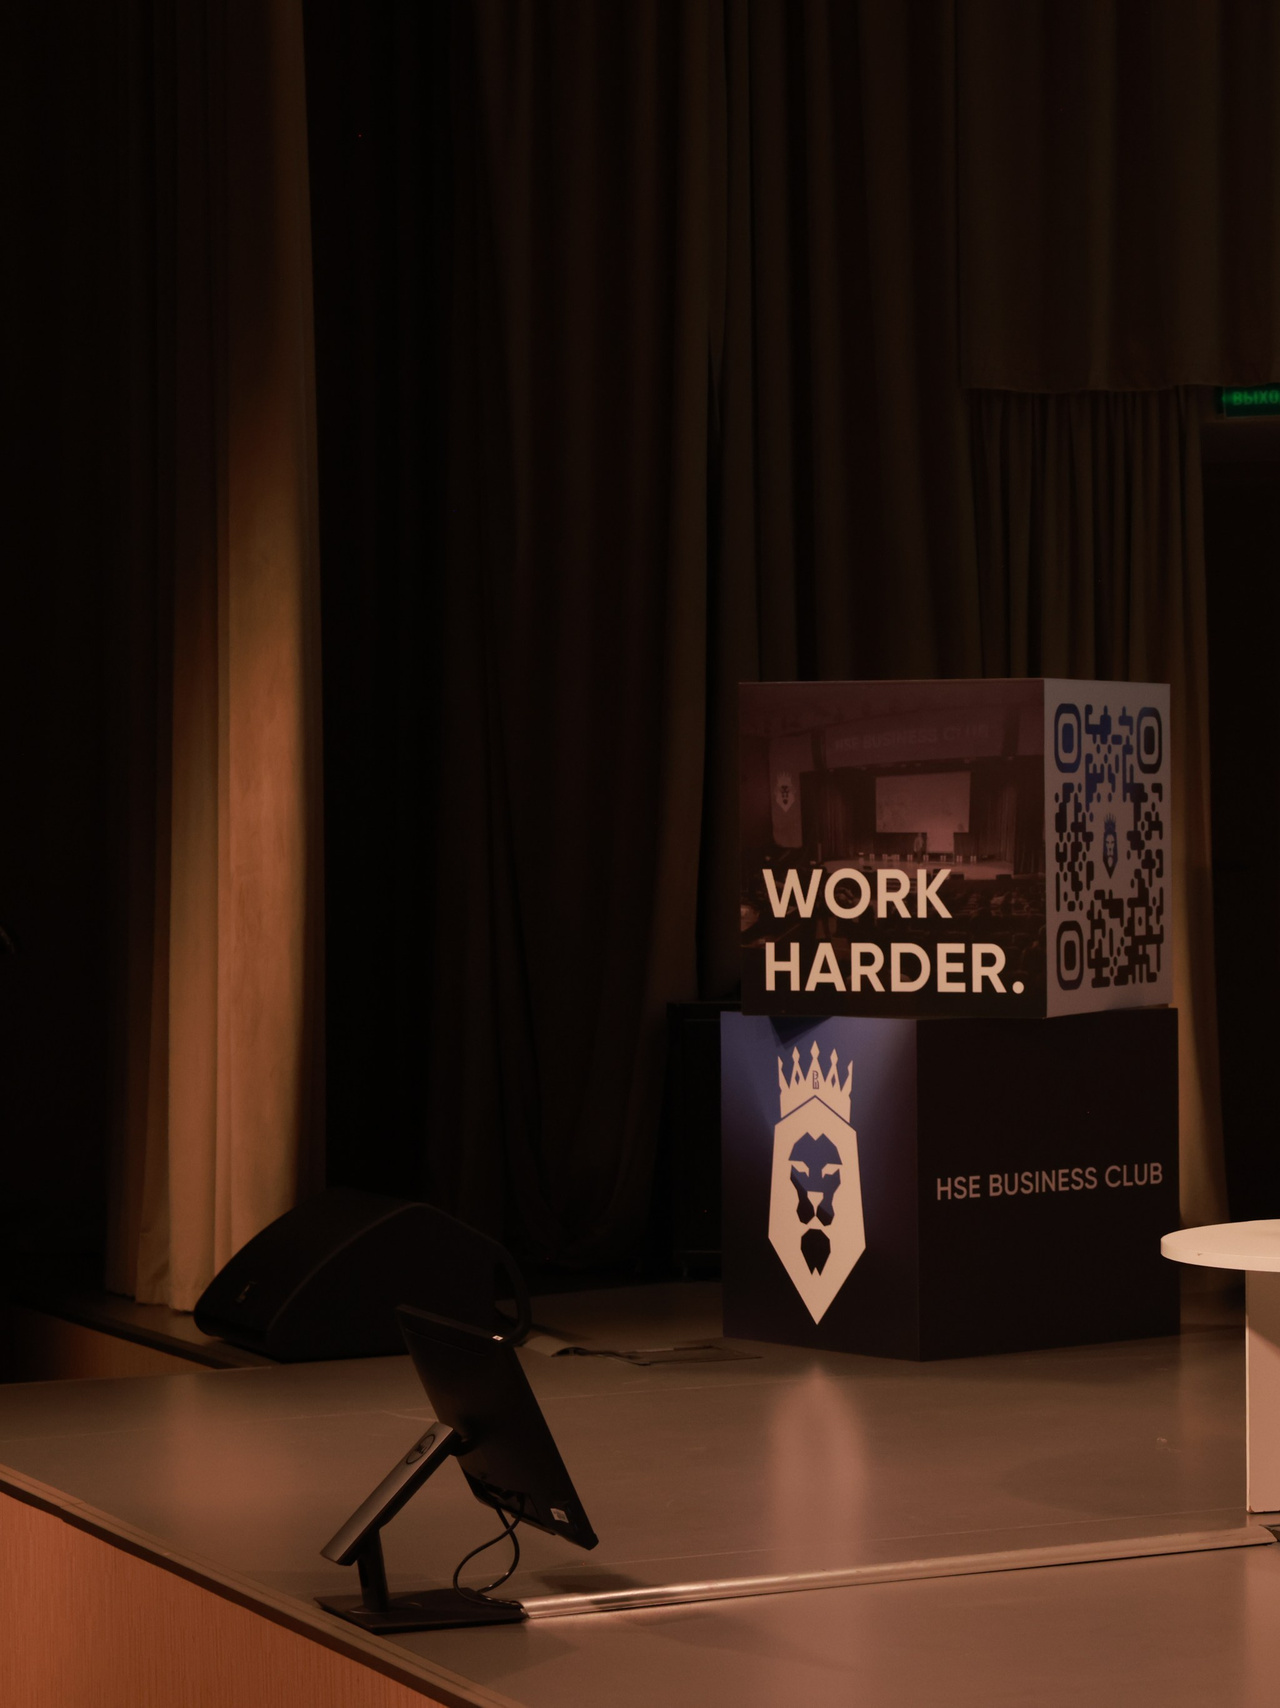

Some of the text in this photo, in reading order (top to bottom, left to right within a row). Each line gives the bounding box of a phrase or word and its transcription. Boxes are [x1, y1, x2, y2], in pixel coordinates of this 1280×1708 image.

[762, 868, 952, 919] WORK
[765, 942, 1025, 994] HARDER.
[936, 1162, 1163, 1200] HSE BUSINESS CLUB
